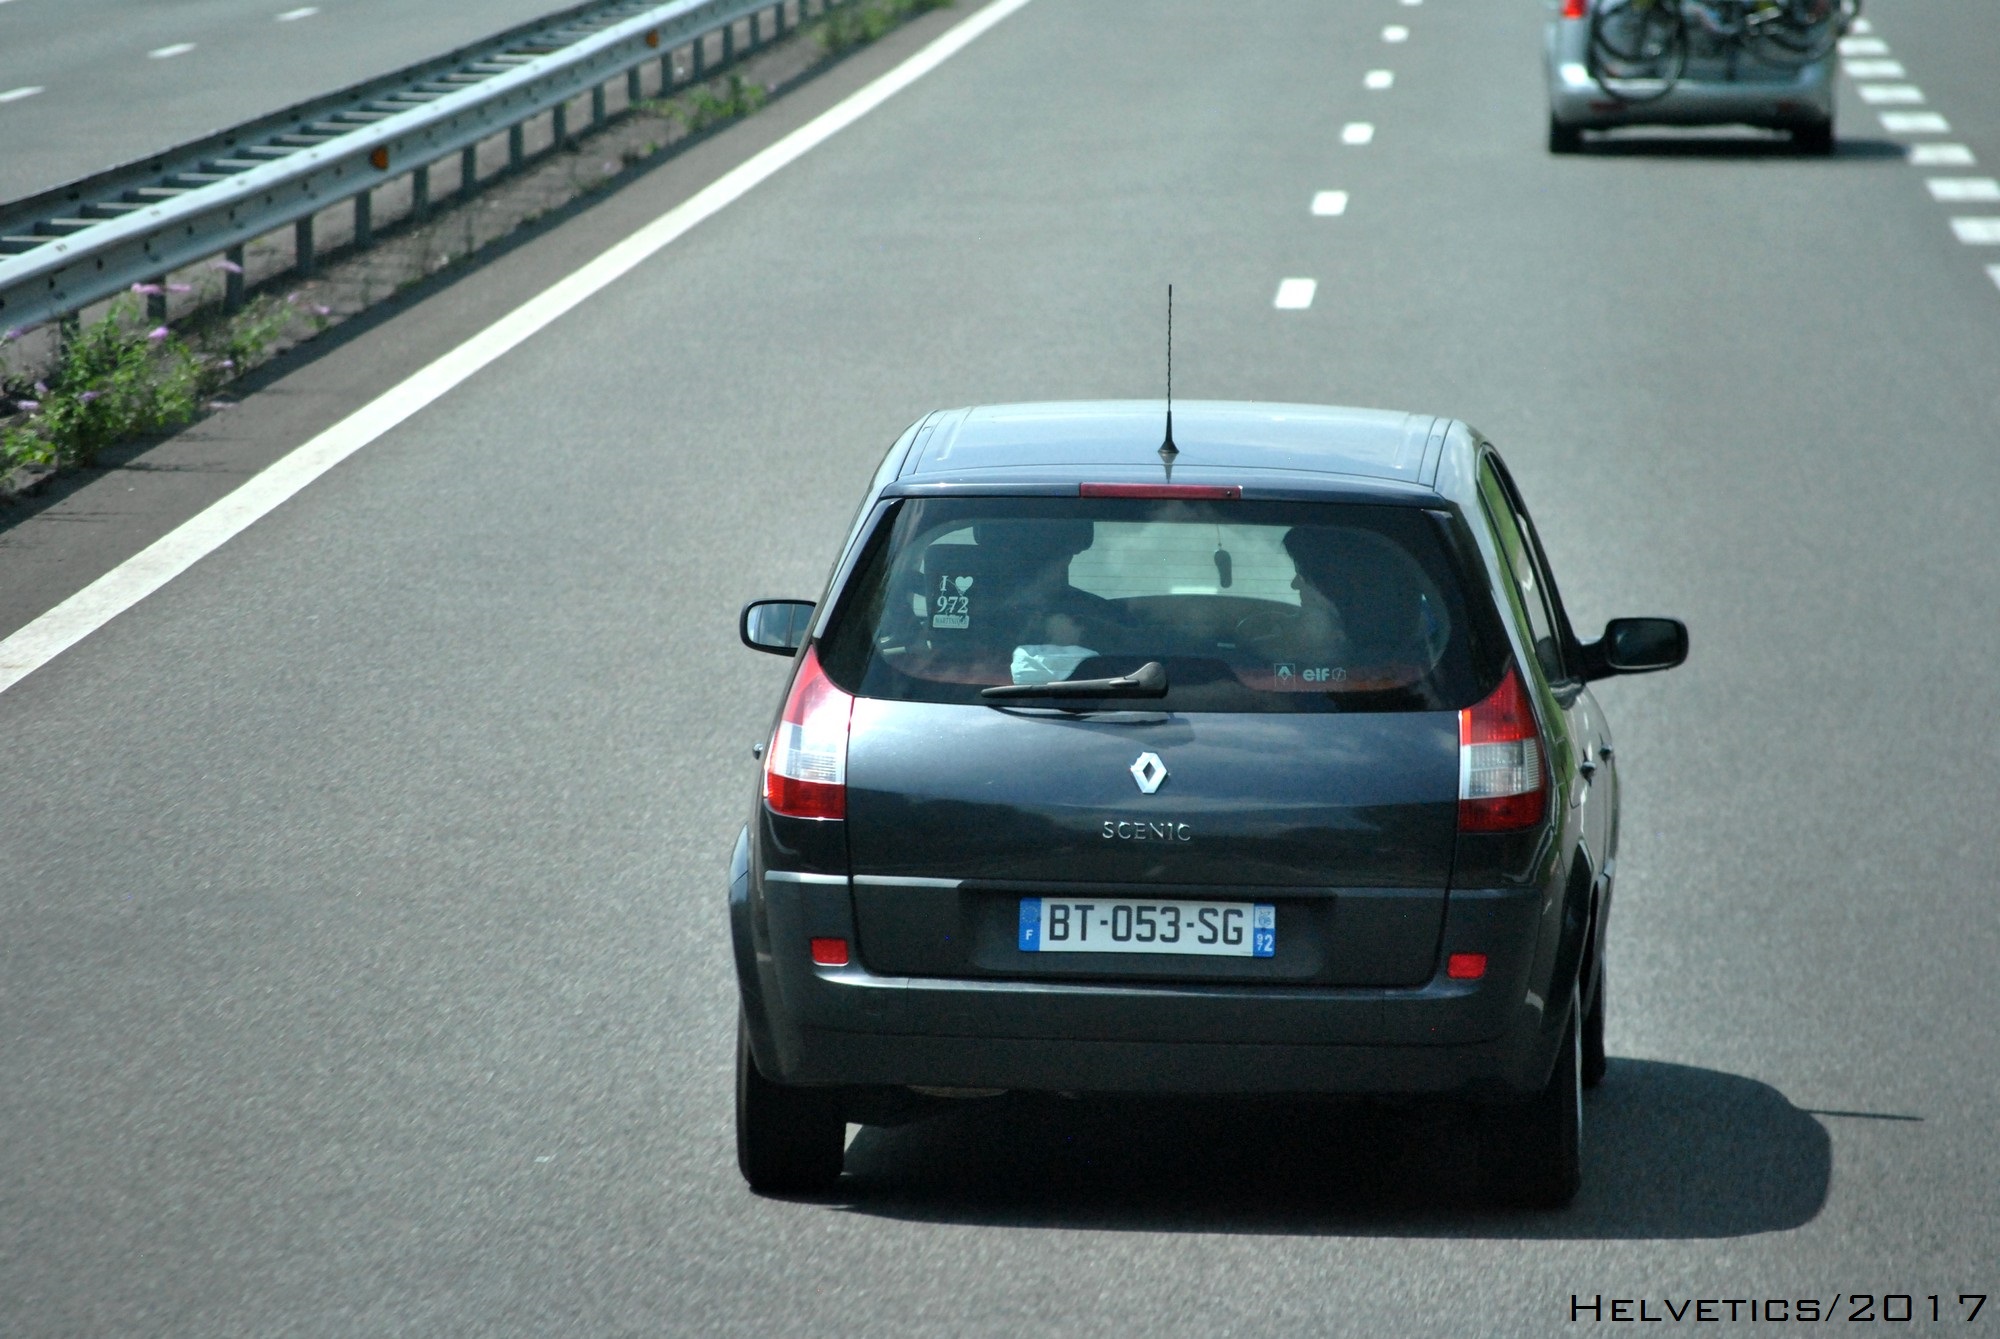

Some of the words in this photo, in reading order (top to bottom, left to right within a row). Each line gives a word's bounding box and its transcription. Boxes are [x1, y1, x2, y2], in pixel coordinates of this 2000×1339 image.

[940, 575, 949, 591] I
[937, 596, 969, 613] 972
[1303, 668, 1330, 682] elf
[1102, 821, 1191, 841] SCENIC
[1025, 930, 1033, 940] F
[1049, 904, 1243, 945] BT-053-SG
